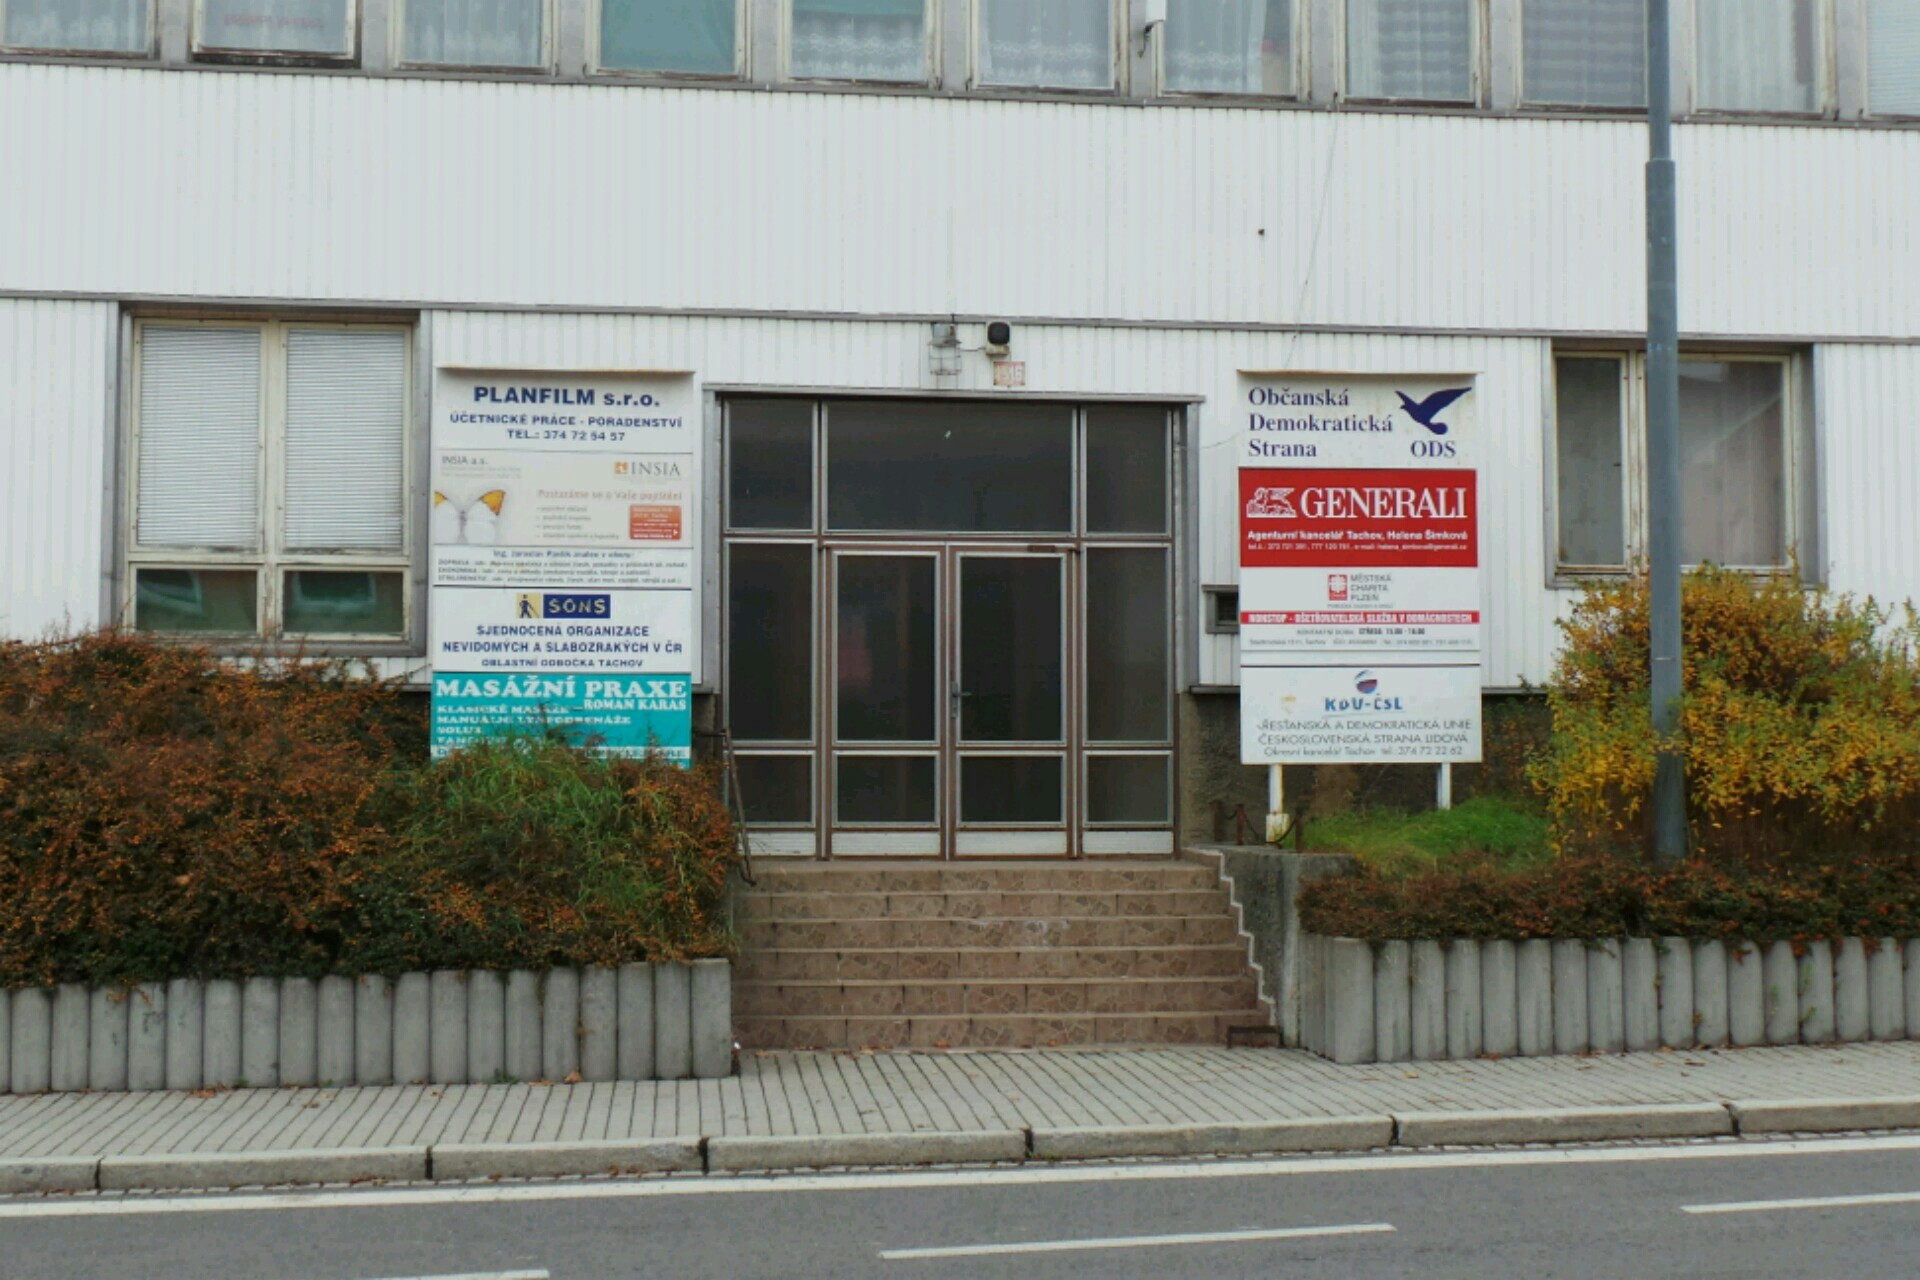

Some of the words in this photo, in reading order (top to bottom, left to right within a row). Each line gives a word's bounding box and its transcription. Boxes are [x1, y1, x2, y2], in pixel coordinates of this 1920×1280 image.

[473, 386, 596, 405] PLANFILM
[603, 390, 661, 407] s.r.o.
[1248, 386, 1349, 406] Občanská
[450, 413, 527, 425] ÚČETNICKÉ
[532, 413, 576, 426] PRÁCE
[587, 415, 682, 428] PORADENSTVÍ
[1248, 413, 1393, 432] Demokratická
[543, 429, 569, 440] 374
[572, 430, 587, 440] 72
[1248, 438, 1317, 458] Strana
[1410, 440, 1457, 458] ODS
[630, 461, 681, 477] INSIA
[1300, 487, 1468, 518] GENERALI
[1387, 530, 1423, 540] Helena
[1351, 572, 1392, 581] MĚSTSKÁ
[548, 598, 606, 613] SONS
[476, 623, 562, 636] SJEDNOCENÁ
[566, 626, 649, 637] ORGANIZACE
[442, 640, 529, 653] NEVIDOMÝCH
[533, 642, 542, 652] A
[546, 641, 649, 653] SLABOZRAKÝCH
[653, 642, 661, 652] V
[665, 641, 683, 653] ČR
[481, 657, 538, 667] OBLASTNÍ
[541, 657, 595, 667] ODBOČKA
[598, 658, 643, 667] TACHOV
[436, 675, 576, 698] MASÁŽNÍ
[584, 680, 687, 698] PRAXE
[437, 703, 508, 714] KLASICKÉ
[583, 698, 634, 710] ROMAN
[638, 699, 686, 710] KARAS
[1325, 694, 1403, 711] KDU-ČSL
[1335, 720, 1344, 730] A
[1347, 719, 1438, 730] DEMOKRATICKÁ
[1443, 719, 1472, 730] UNIE
[1258, 732, 1370, 745] ČESKOSLOVENSKÁ
[1374, 734, 1420, 744] STRANA
[1425, 731, 1468, 744] LIDOVÁ
